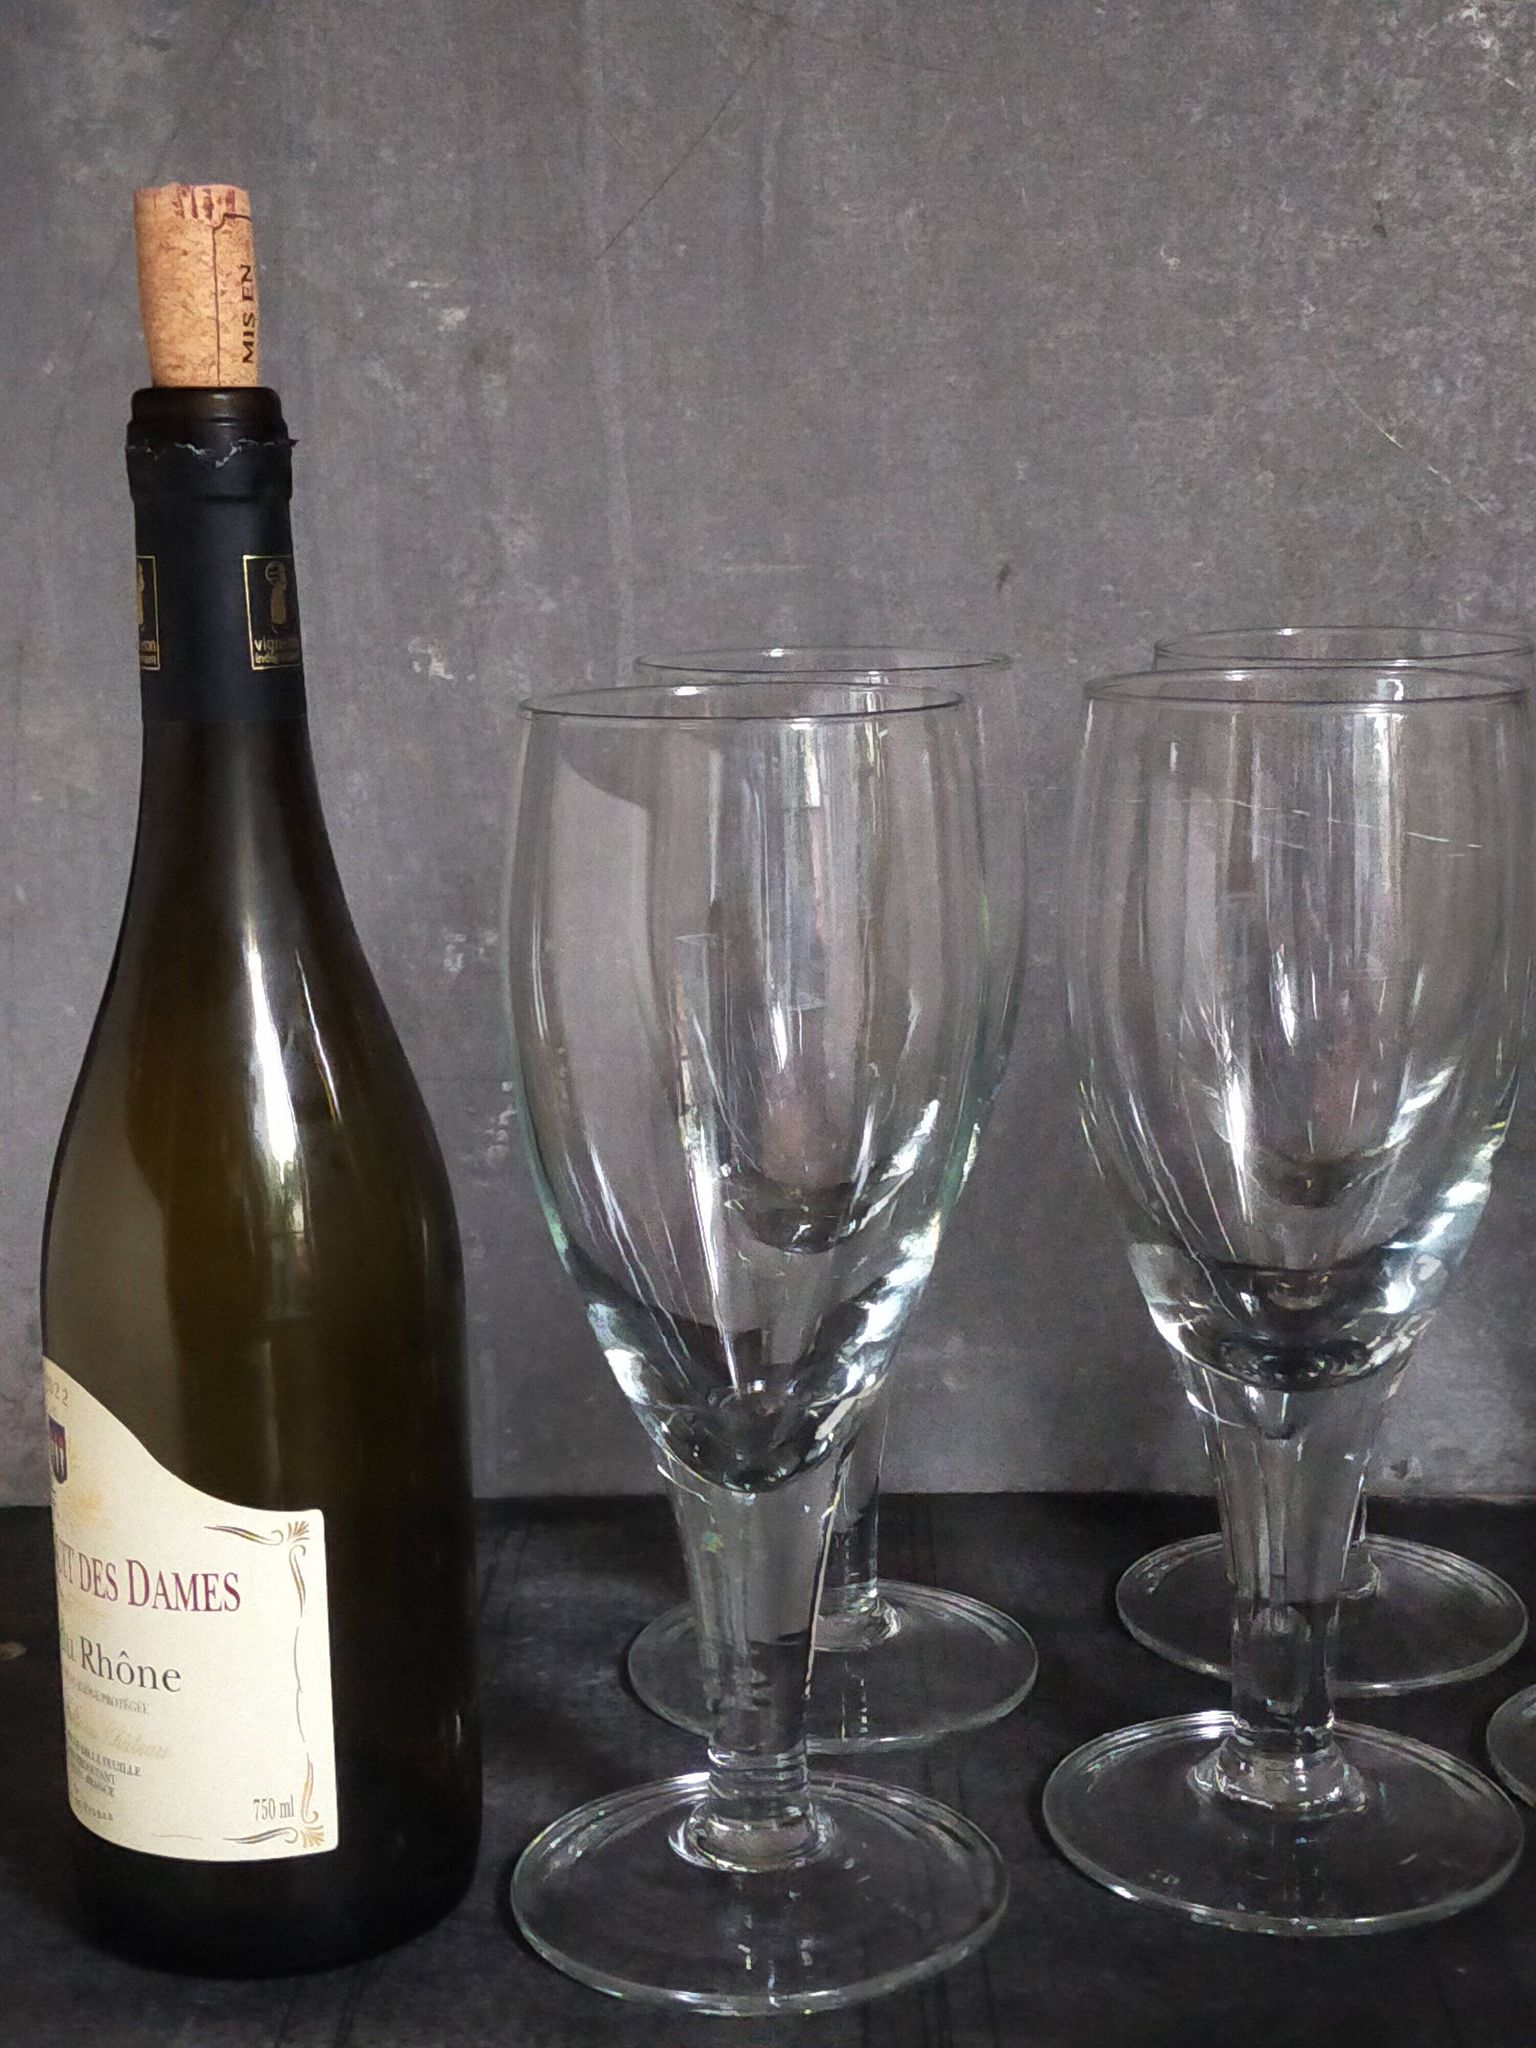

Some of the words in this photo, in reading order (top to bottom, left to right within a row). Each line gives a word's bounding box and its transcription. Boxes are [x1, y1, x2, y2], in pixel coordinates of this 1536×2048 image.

[240, 264, 254, 302] EN
[242, 312, 255, 364] MIS
[78, 1552, 119, 1602] DES
[126, 1558, 242, 1612] DAMES
[80, 1635, 182, 1693] Rhône
[253, 1798, 276, 1821] 750
[280, 1794, 295, 1819] ml
